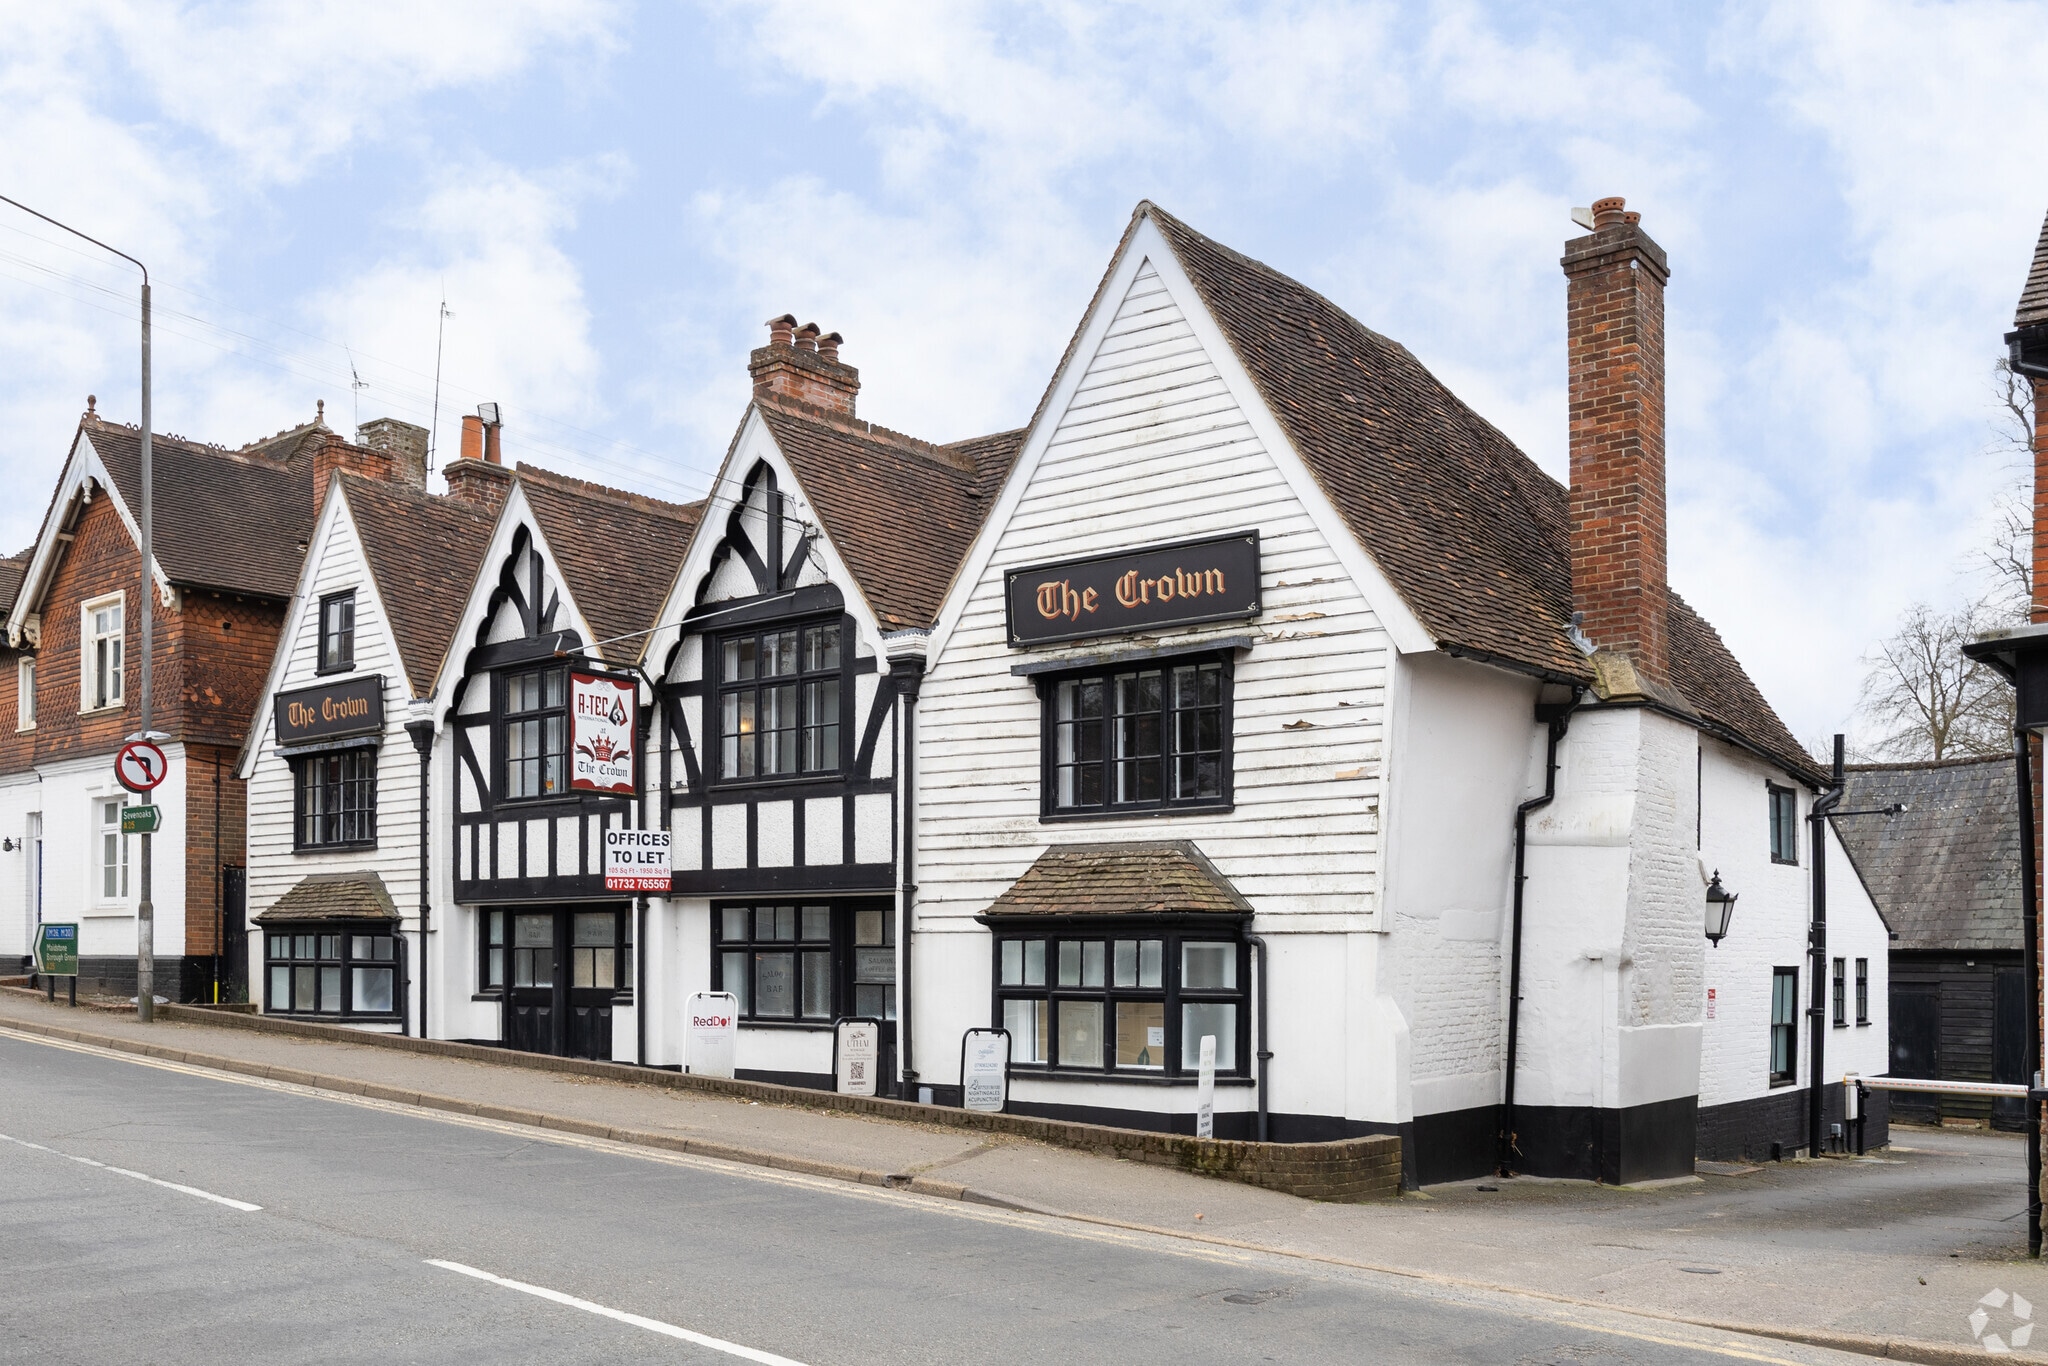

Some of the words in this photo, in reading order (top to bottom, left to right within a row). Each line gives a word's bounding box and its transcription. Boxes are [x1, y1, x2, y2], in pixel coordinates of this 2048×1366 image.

[1036, 579, 1099, 622] The
[1115, 566, 1226, 609] Crown
[578, 693, 609, 717] A-TEC
[288, 701, 316, 729] The
[321, 696, 368, 721] Crown
[578, 715, 608, 723] INTERNATIONAL
[578, 761, 595, 774] The
[599, 763, 628, 777] Crown
[123, 810, 152, 820] Sevenoaks
[607, 832, 670, 846] OFFICES
[612, 850, 632, 863] TO
[637, 851, 665, 864] LET
[619, 867, 628, 875] Sq
[654, 867, 662, 875] Sq
[607, 878, 635, 889] 01732
[636, 878, 670, 889] 765567
[46, 943, 67, 952] Maidstone
[46, 953, 63, 962] Borough
[63, 953, 77, 961] Green
[693, 1015, 731, 1027] RedDot
